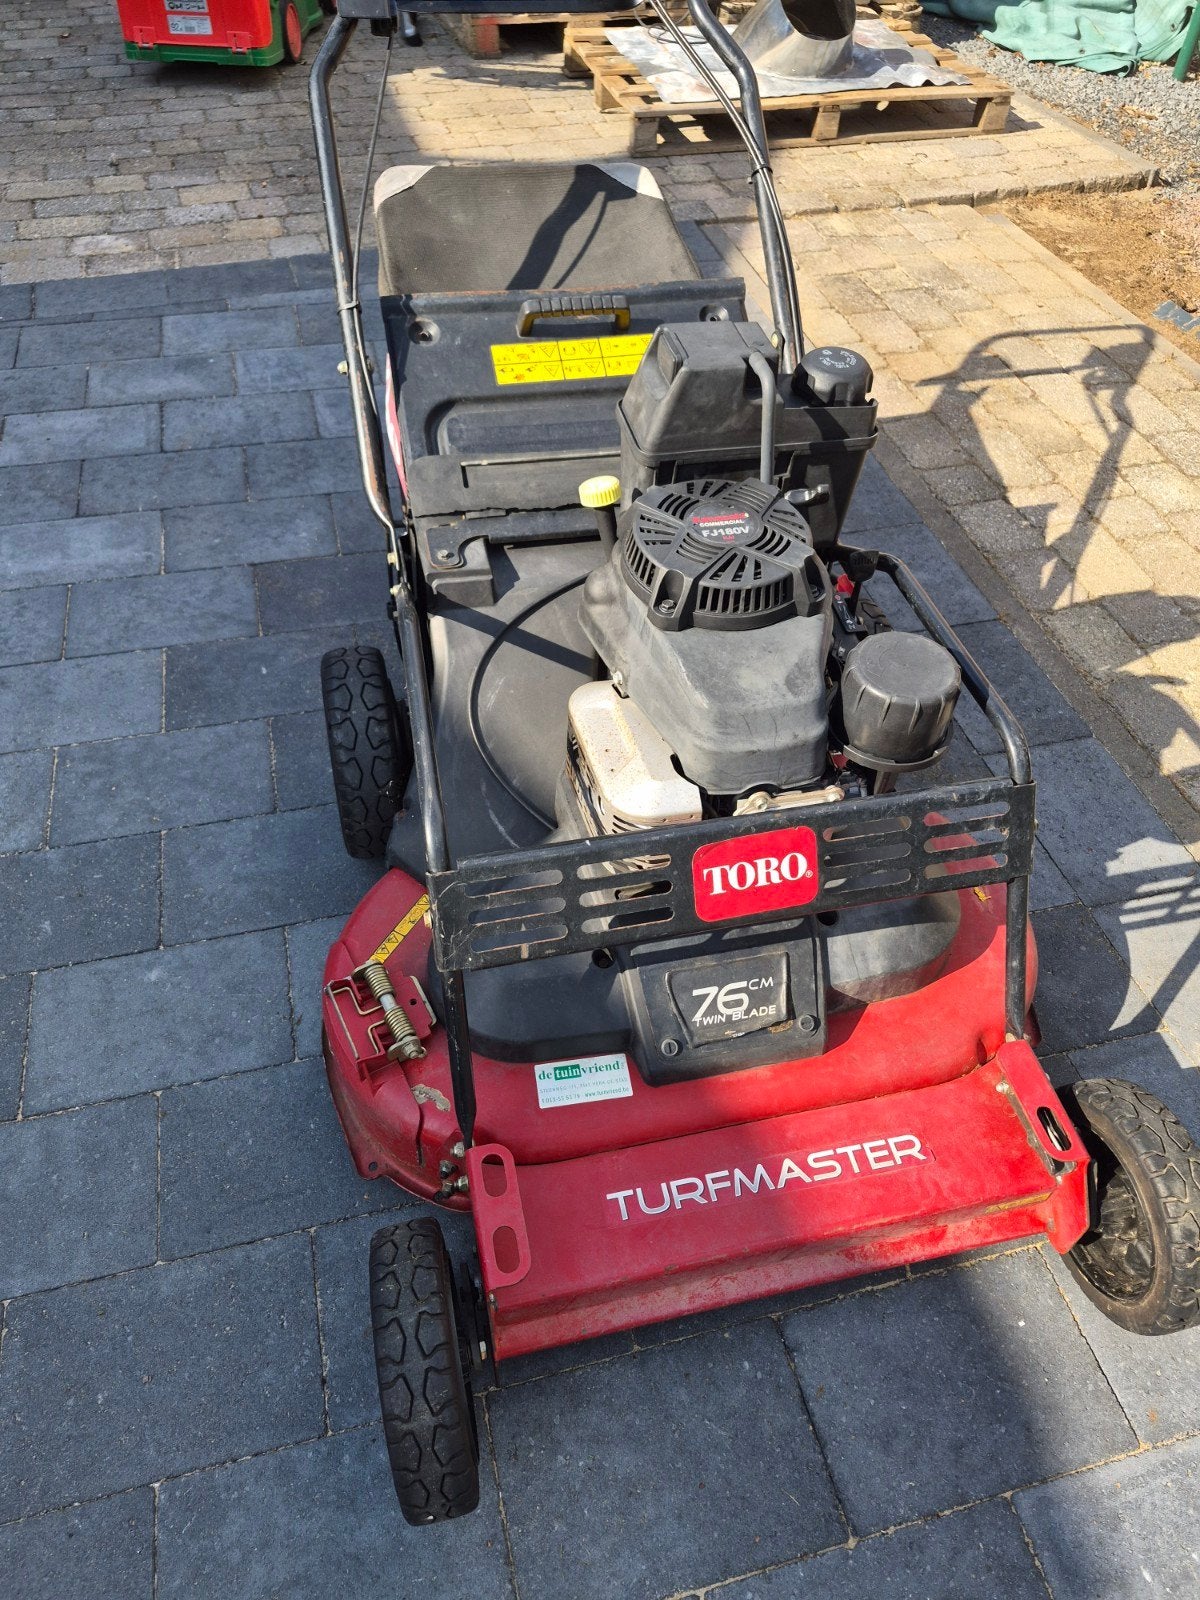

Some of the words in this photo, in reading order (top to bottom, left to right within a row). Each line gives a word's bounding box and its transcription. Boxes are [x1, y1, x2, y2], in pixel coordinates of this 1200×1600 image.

[699, 519, 745, 528] COMMERCIAL
[701, 525, 750, 538] FJ180V
[703, 852, 808, 896] TORO
[691, 980, 750, 1022] 76
[748, 976, 774, 991] CM
[692, 1013, 727, 1027] TWIN
[731, 1004, 777, 1021] BLADE
[605, 1134, 928, 1221] TURFMASTER
